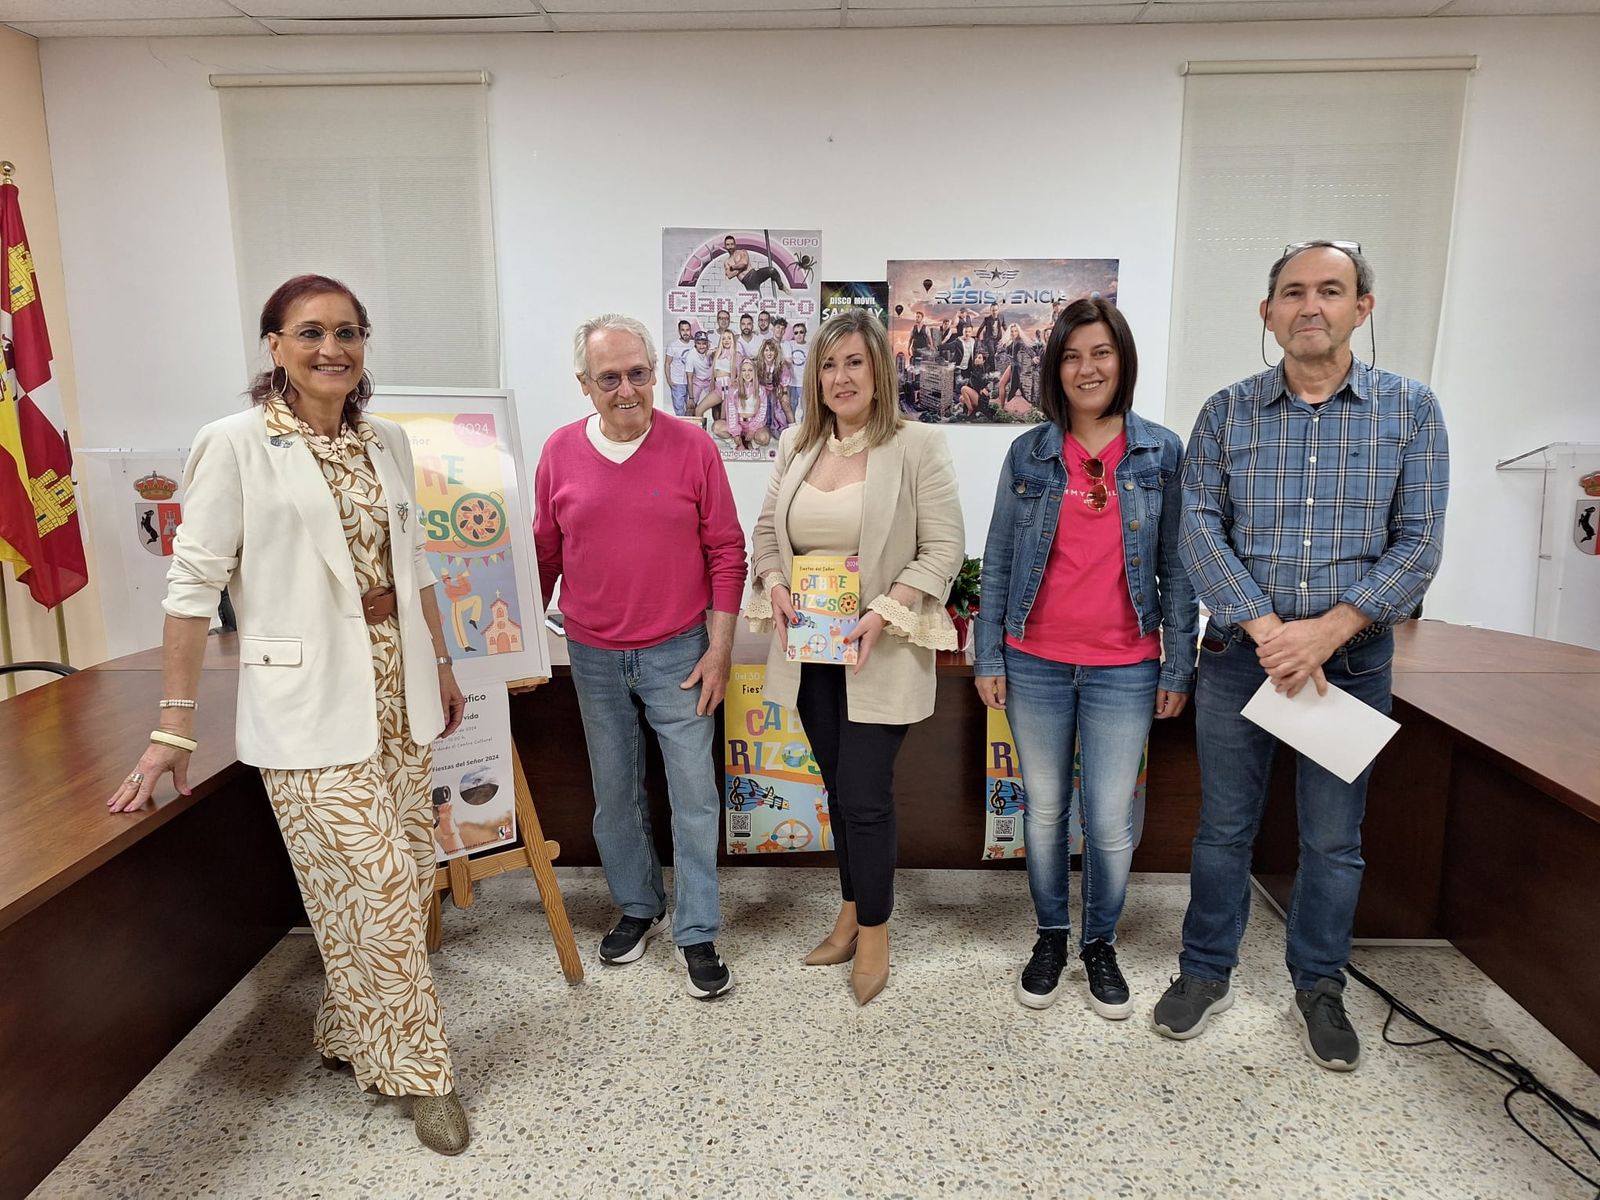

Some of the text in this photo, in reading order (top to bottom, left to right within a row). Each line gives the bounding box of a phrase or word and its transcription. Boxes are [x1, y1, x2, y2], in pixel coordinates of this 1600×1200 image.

[782, 237, 819, 247] GRUPO
[953, 277, 972, 288] LA
[830, 296, 876, 305] DISCO MÓVIL
[466, 758, 484, 766] Señor
[485, 754, 499, 762] 2024
